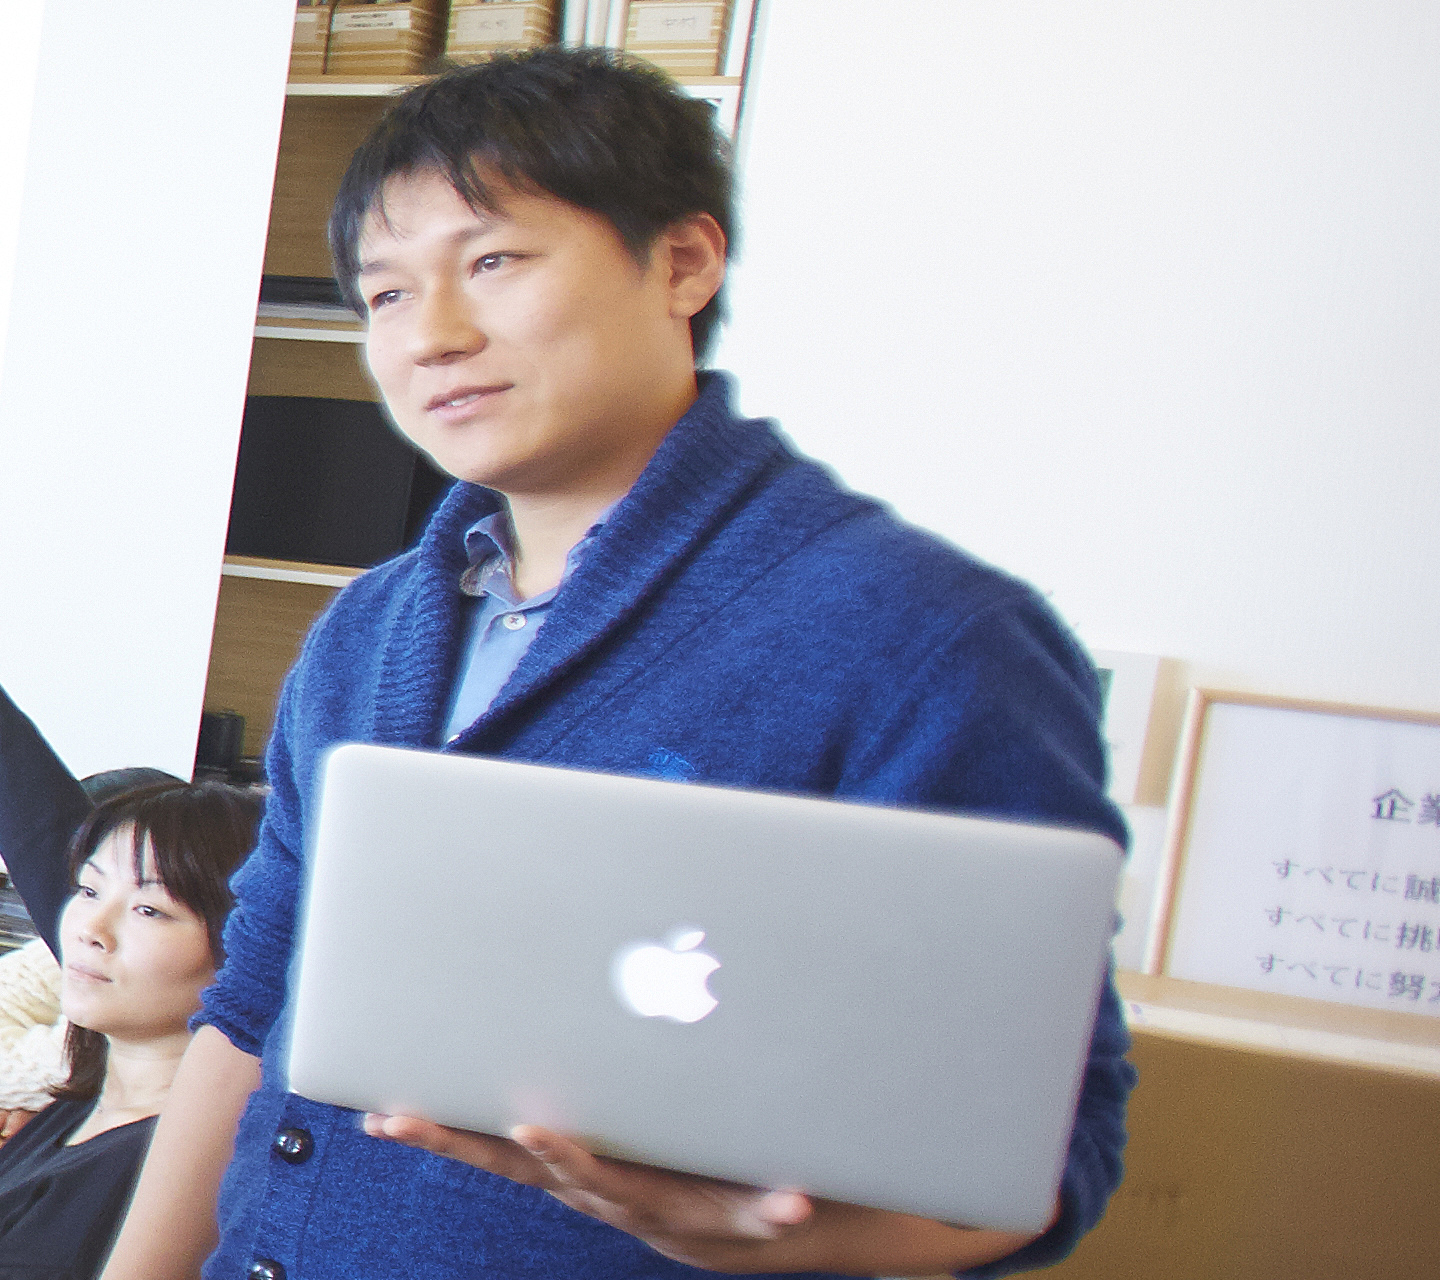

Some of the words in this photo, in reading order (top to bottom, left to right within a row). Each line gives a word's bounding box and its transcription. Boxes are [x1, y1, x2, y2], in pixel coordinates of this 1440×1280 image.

[1264, 906, 1440, 953] すべてに挑
